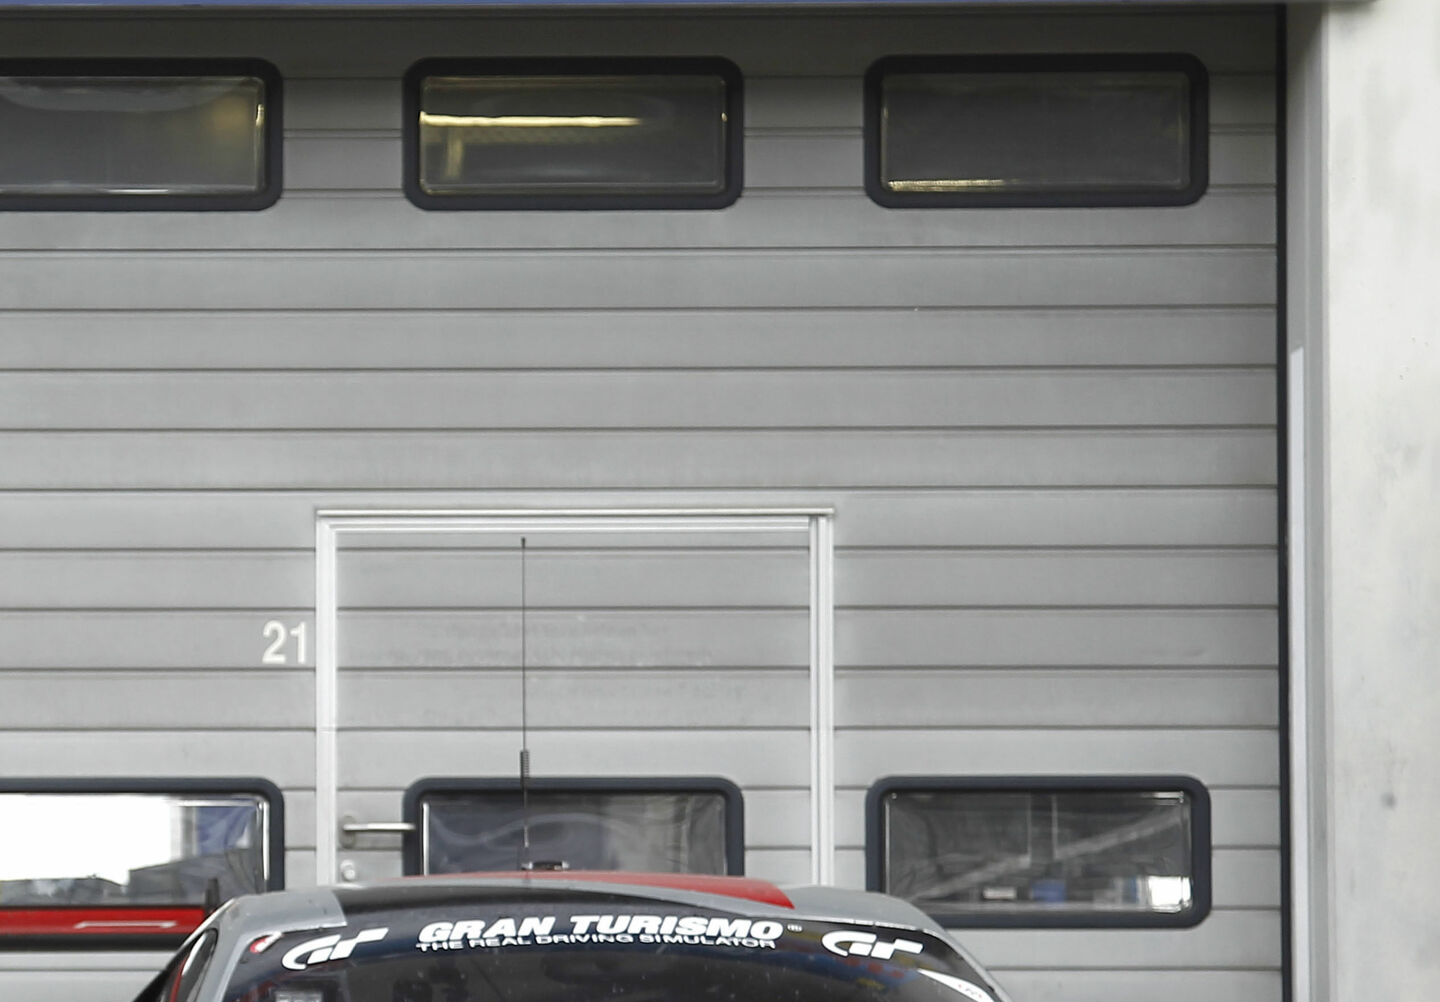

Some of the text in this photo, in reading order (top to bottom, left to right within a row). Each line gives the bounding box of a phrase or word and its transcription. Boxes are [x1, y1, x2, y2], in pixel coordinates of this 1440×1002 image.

[262, 620, 306, 664] 21
[416, 934, 776, 952] THE REAL DRIVING SIMULATOR
[418, 915, 784, 943] GRAN TURISMO
